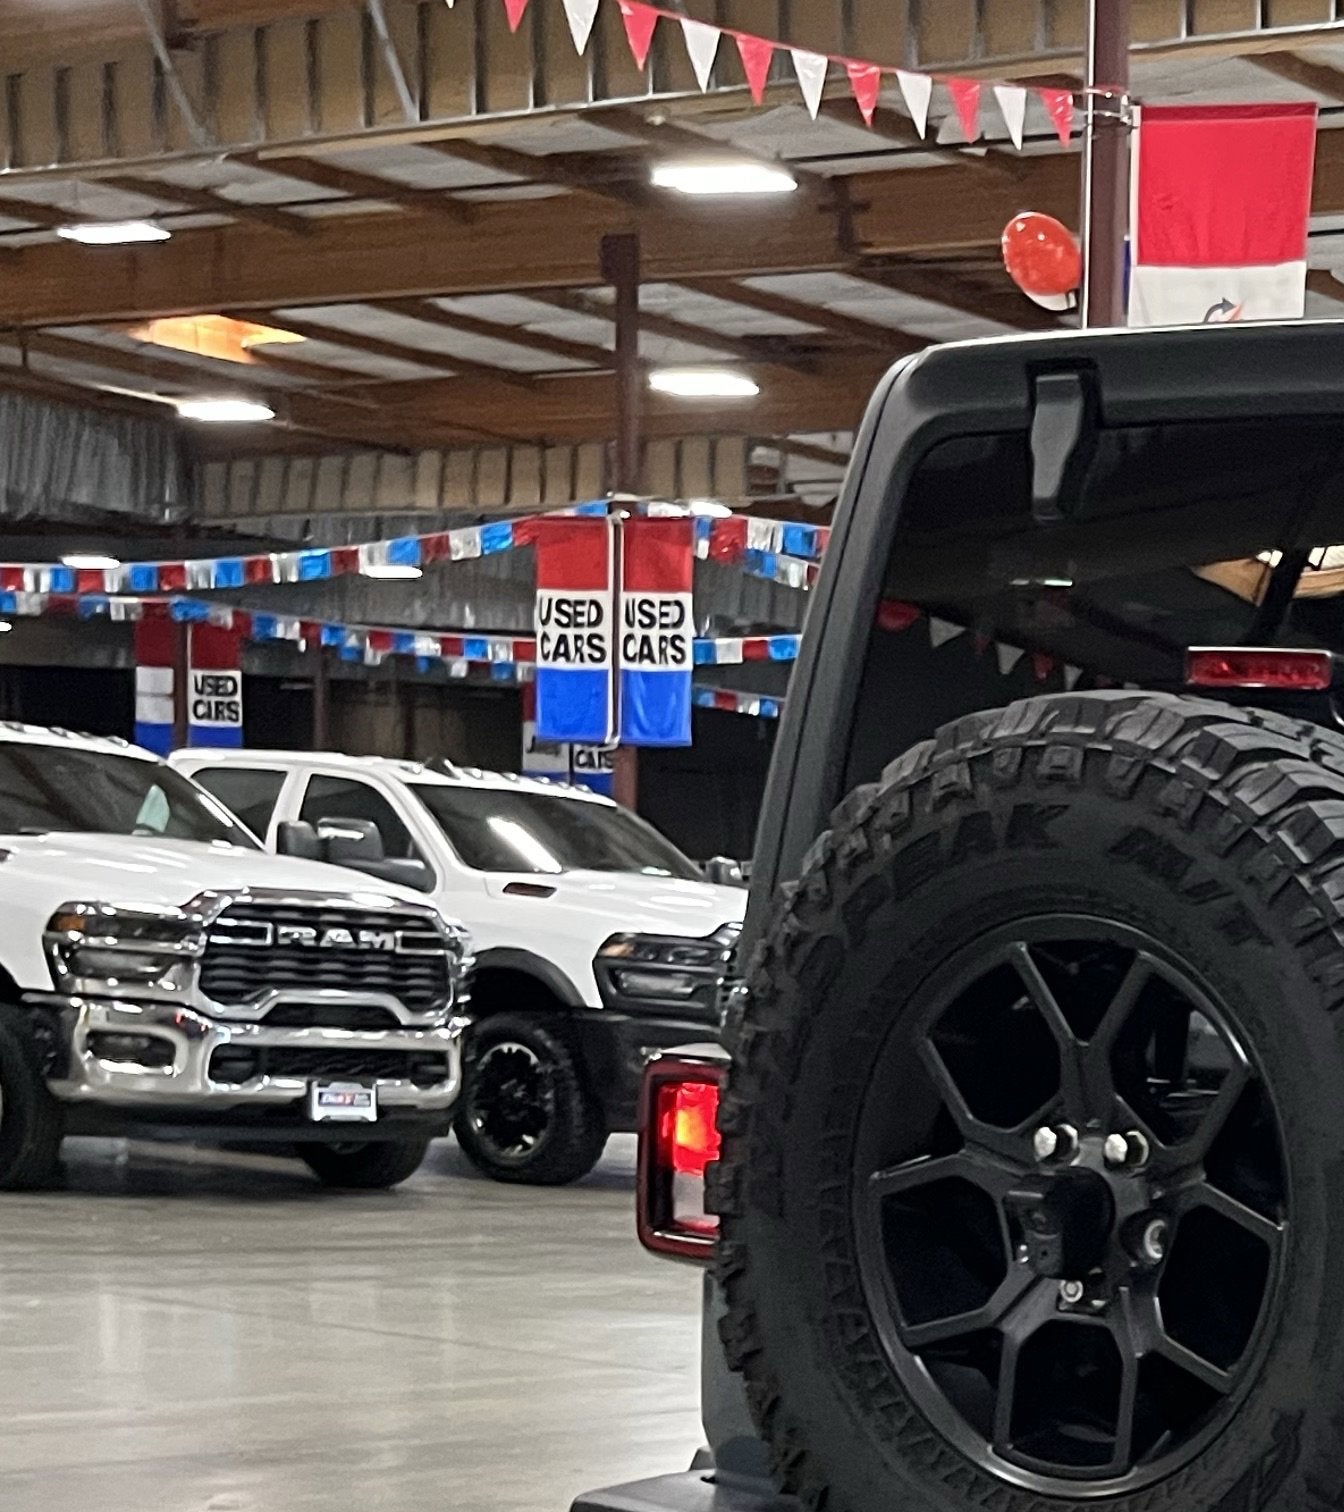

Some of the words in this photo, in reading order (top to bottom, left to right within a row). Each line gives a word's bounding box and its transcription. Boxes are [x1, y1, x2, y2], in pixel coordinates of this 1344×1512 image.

[539, 597, 604, 629] USED
[625, 598, 685, 630] USED
[540, 631, 607, 664] CARS
[623, 633, 687, 665] CARS
[194, 675, 238, 696] USED
[193, 699, 240, 722] CARS
[278, 925, 395, 950] RAM
